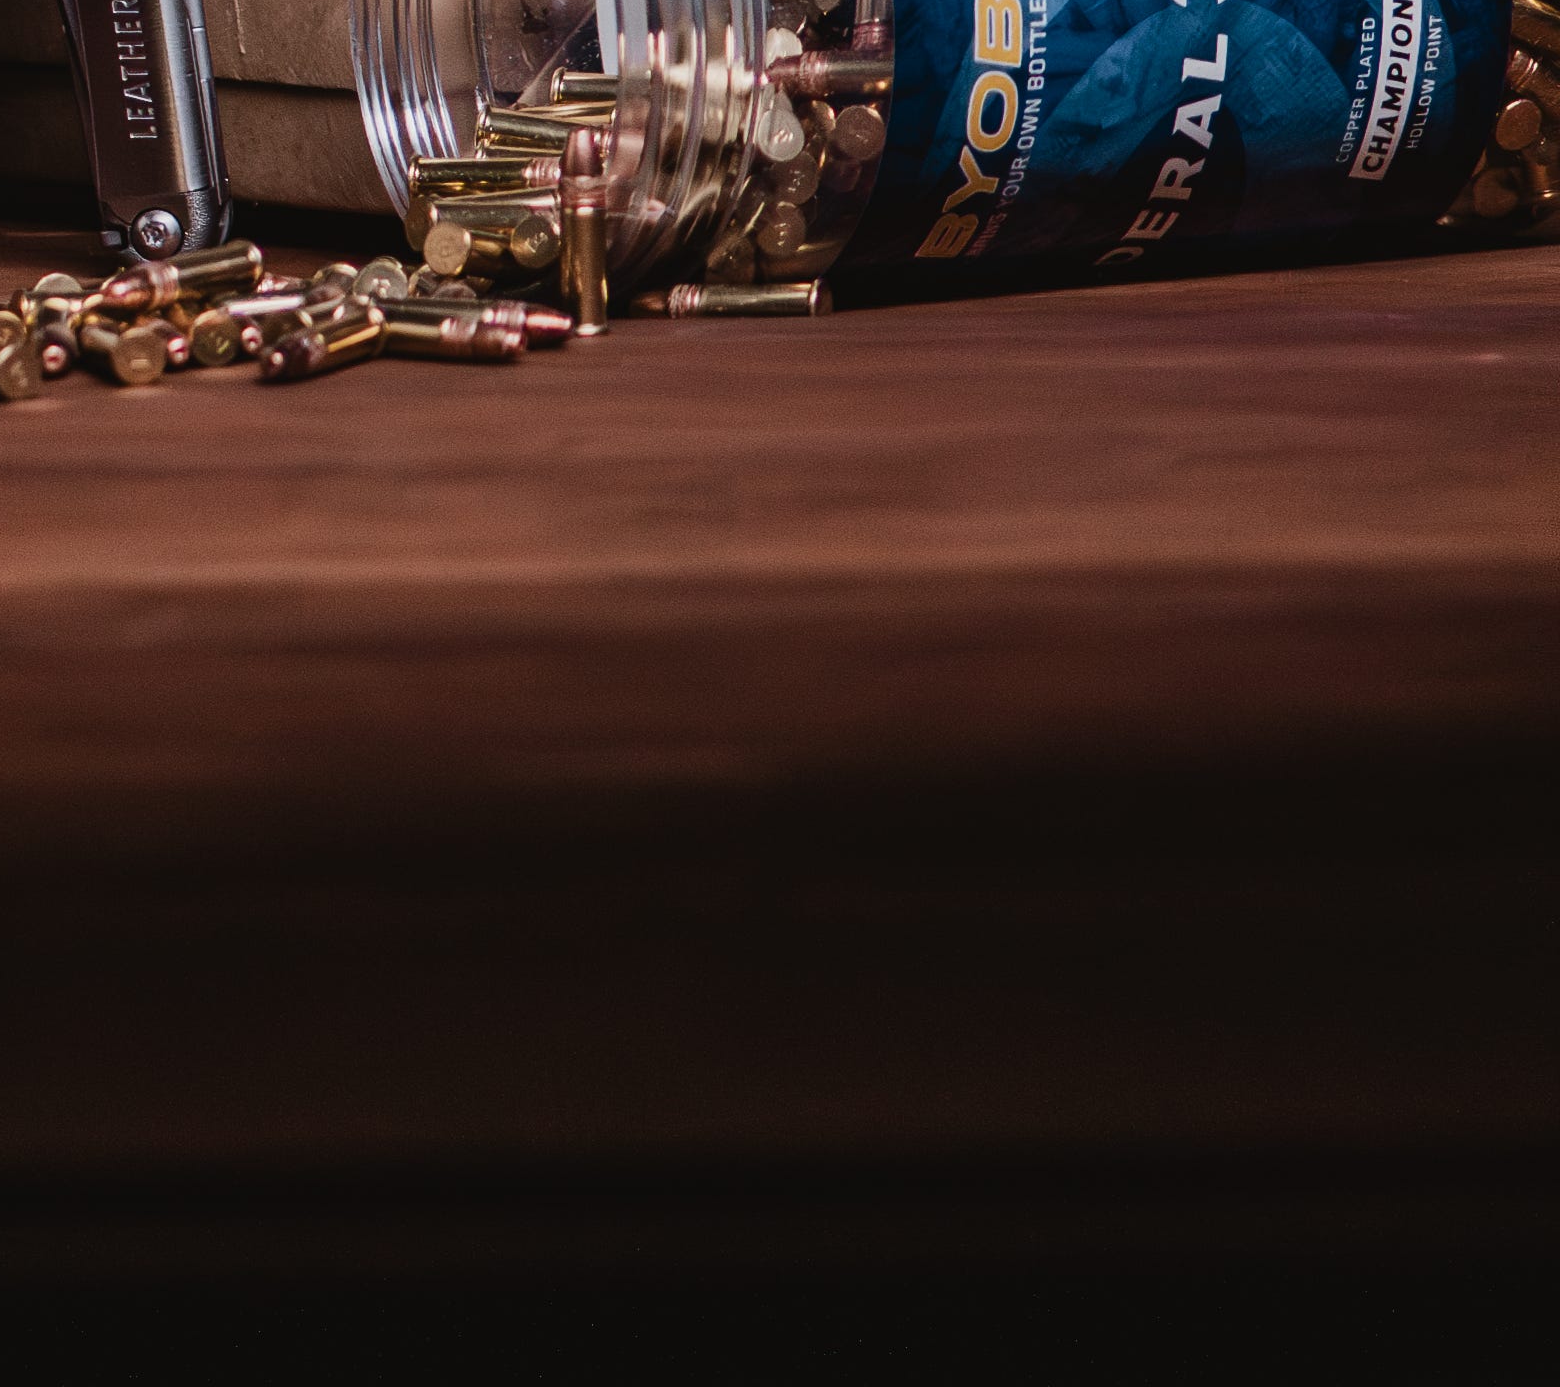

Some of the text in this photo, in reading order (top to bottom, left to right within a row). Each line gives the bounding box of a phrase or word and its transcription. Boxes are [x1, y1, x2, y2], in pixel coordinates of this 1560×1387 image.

[1335, 16, 1377, 164] COPPER PLATED
[1407, 15, 1443, 150] HOLLOW POINT
[997, 154, 1030, 207] YOUR
[1017, 98, 1042, 150] OWN
